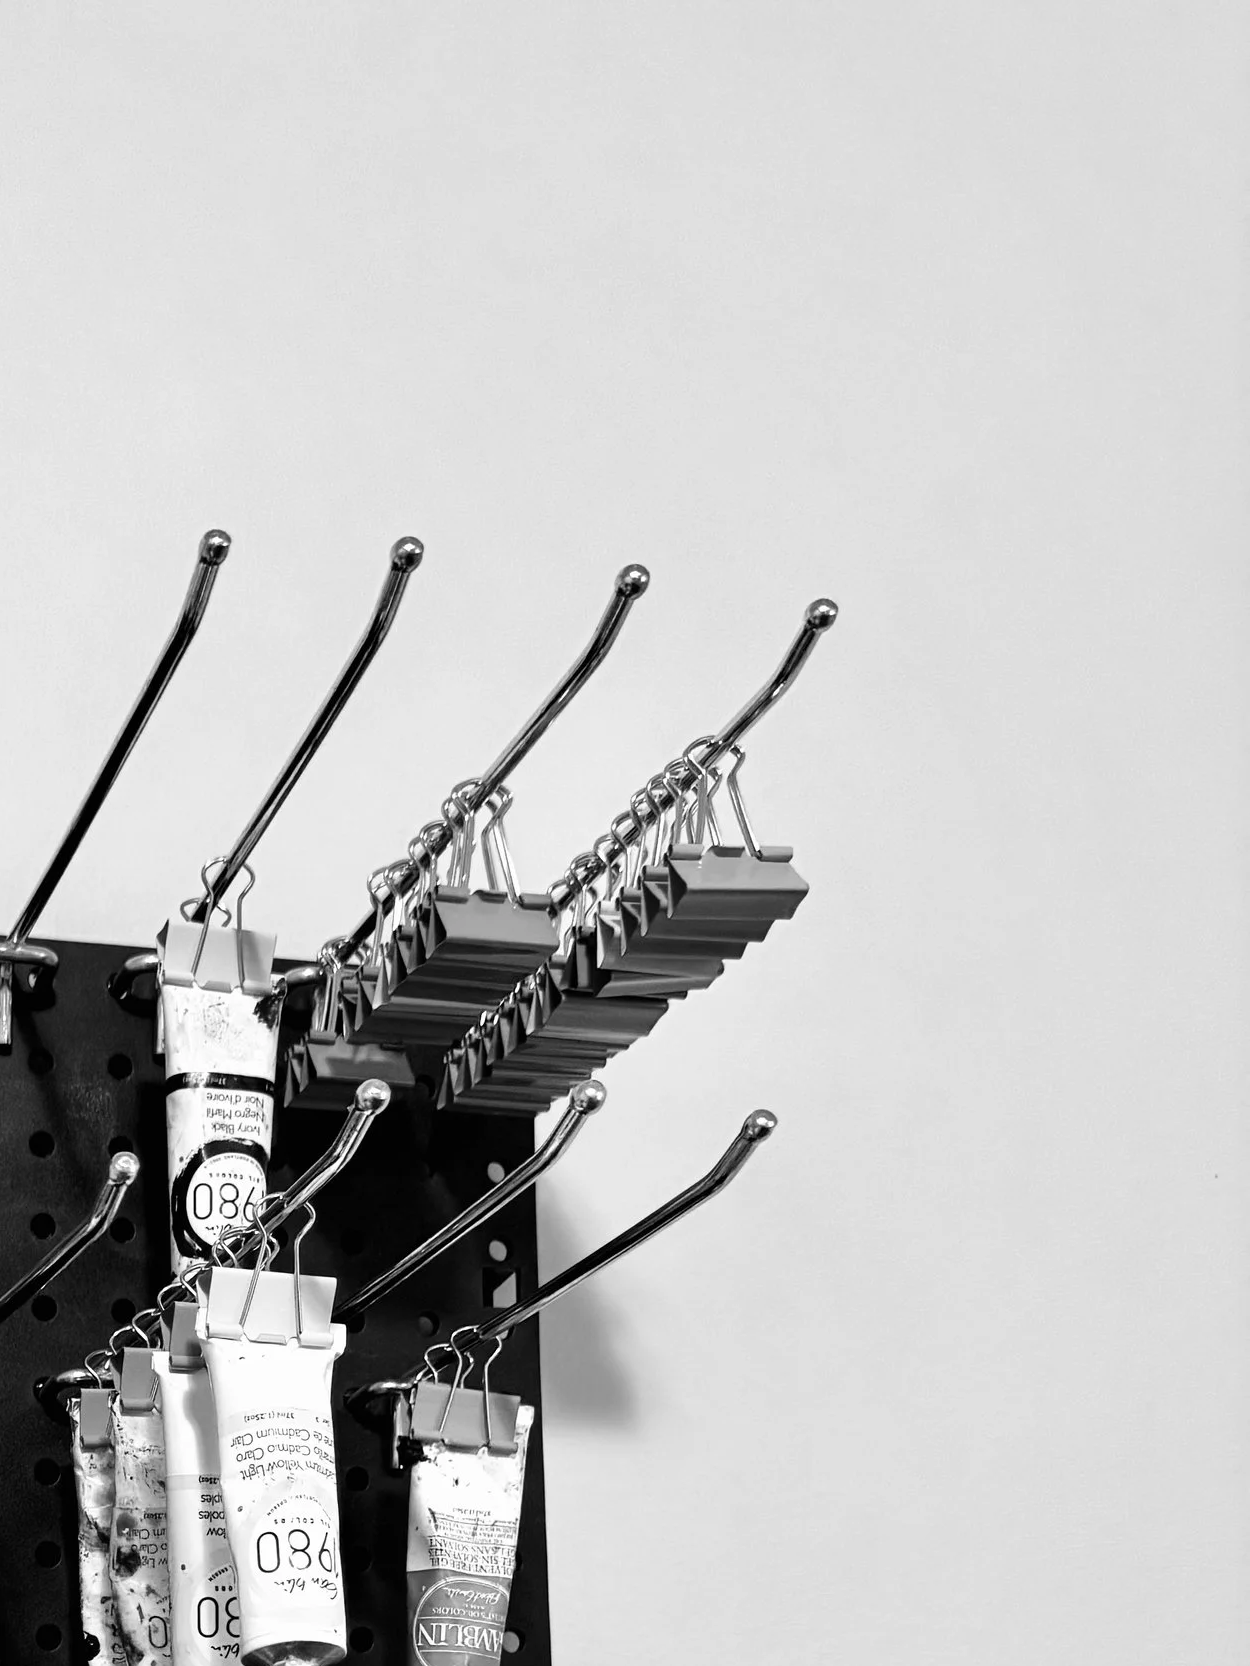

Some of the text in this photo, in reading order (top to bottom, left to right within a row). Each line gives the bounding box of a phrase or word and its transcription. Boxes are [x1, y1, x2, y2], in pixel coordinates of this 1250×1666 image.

[245, 1095, 265, 1110] Noir
[234, 1107, 265, 1123] Negro
[211, 1123, 261, 1137] Ivory Black
[230, 1432, 254, 1450] Clair
[235, 1447, 265, 1463] Claro
[239, 1463, 266, 1481] Light
[198, 1510, 226, 1523] poles
